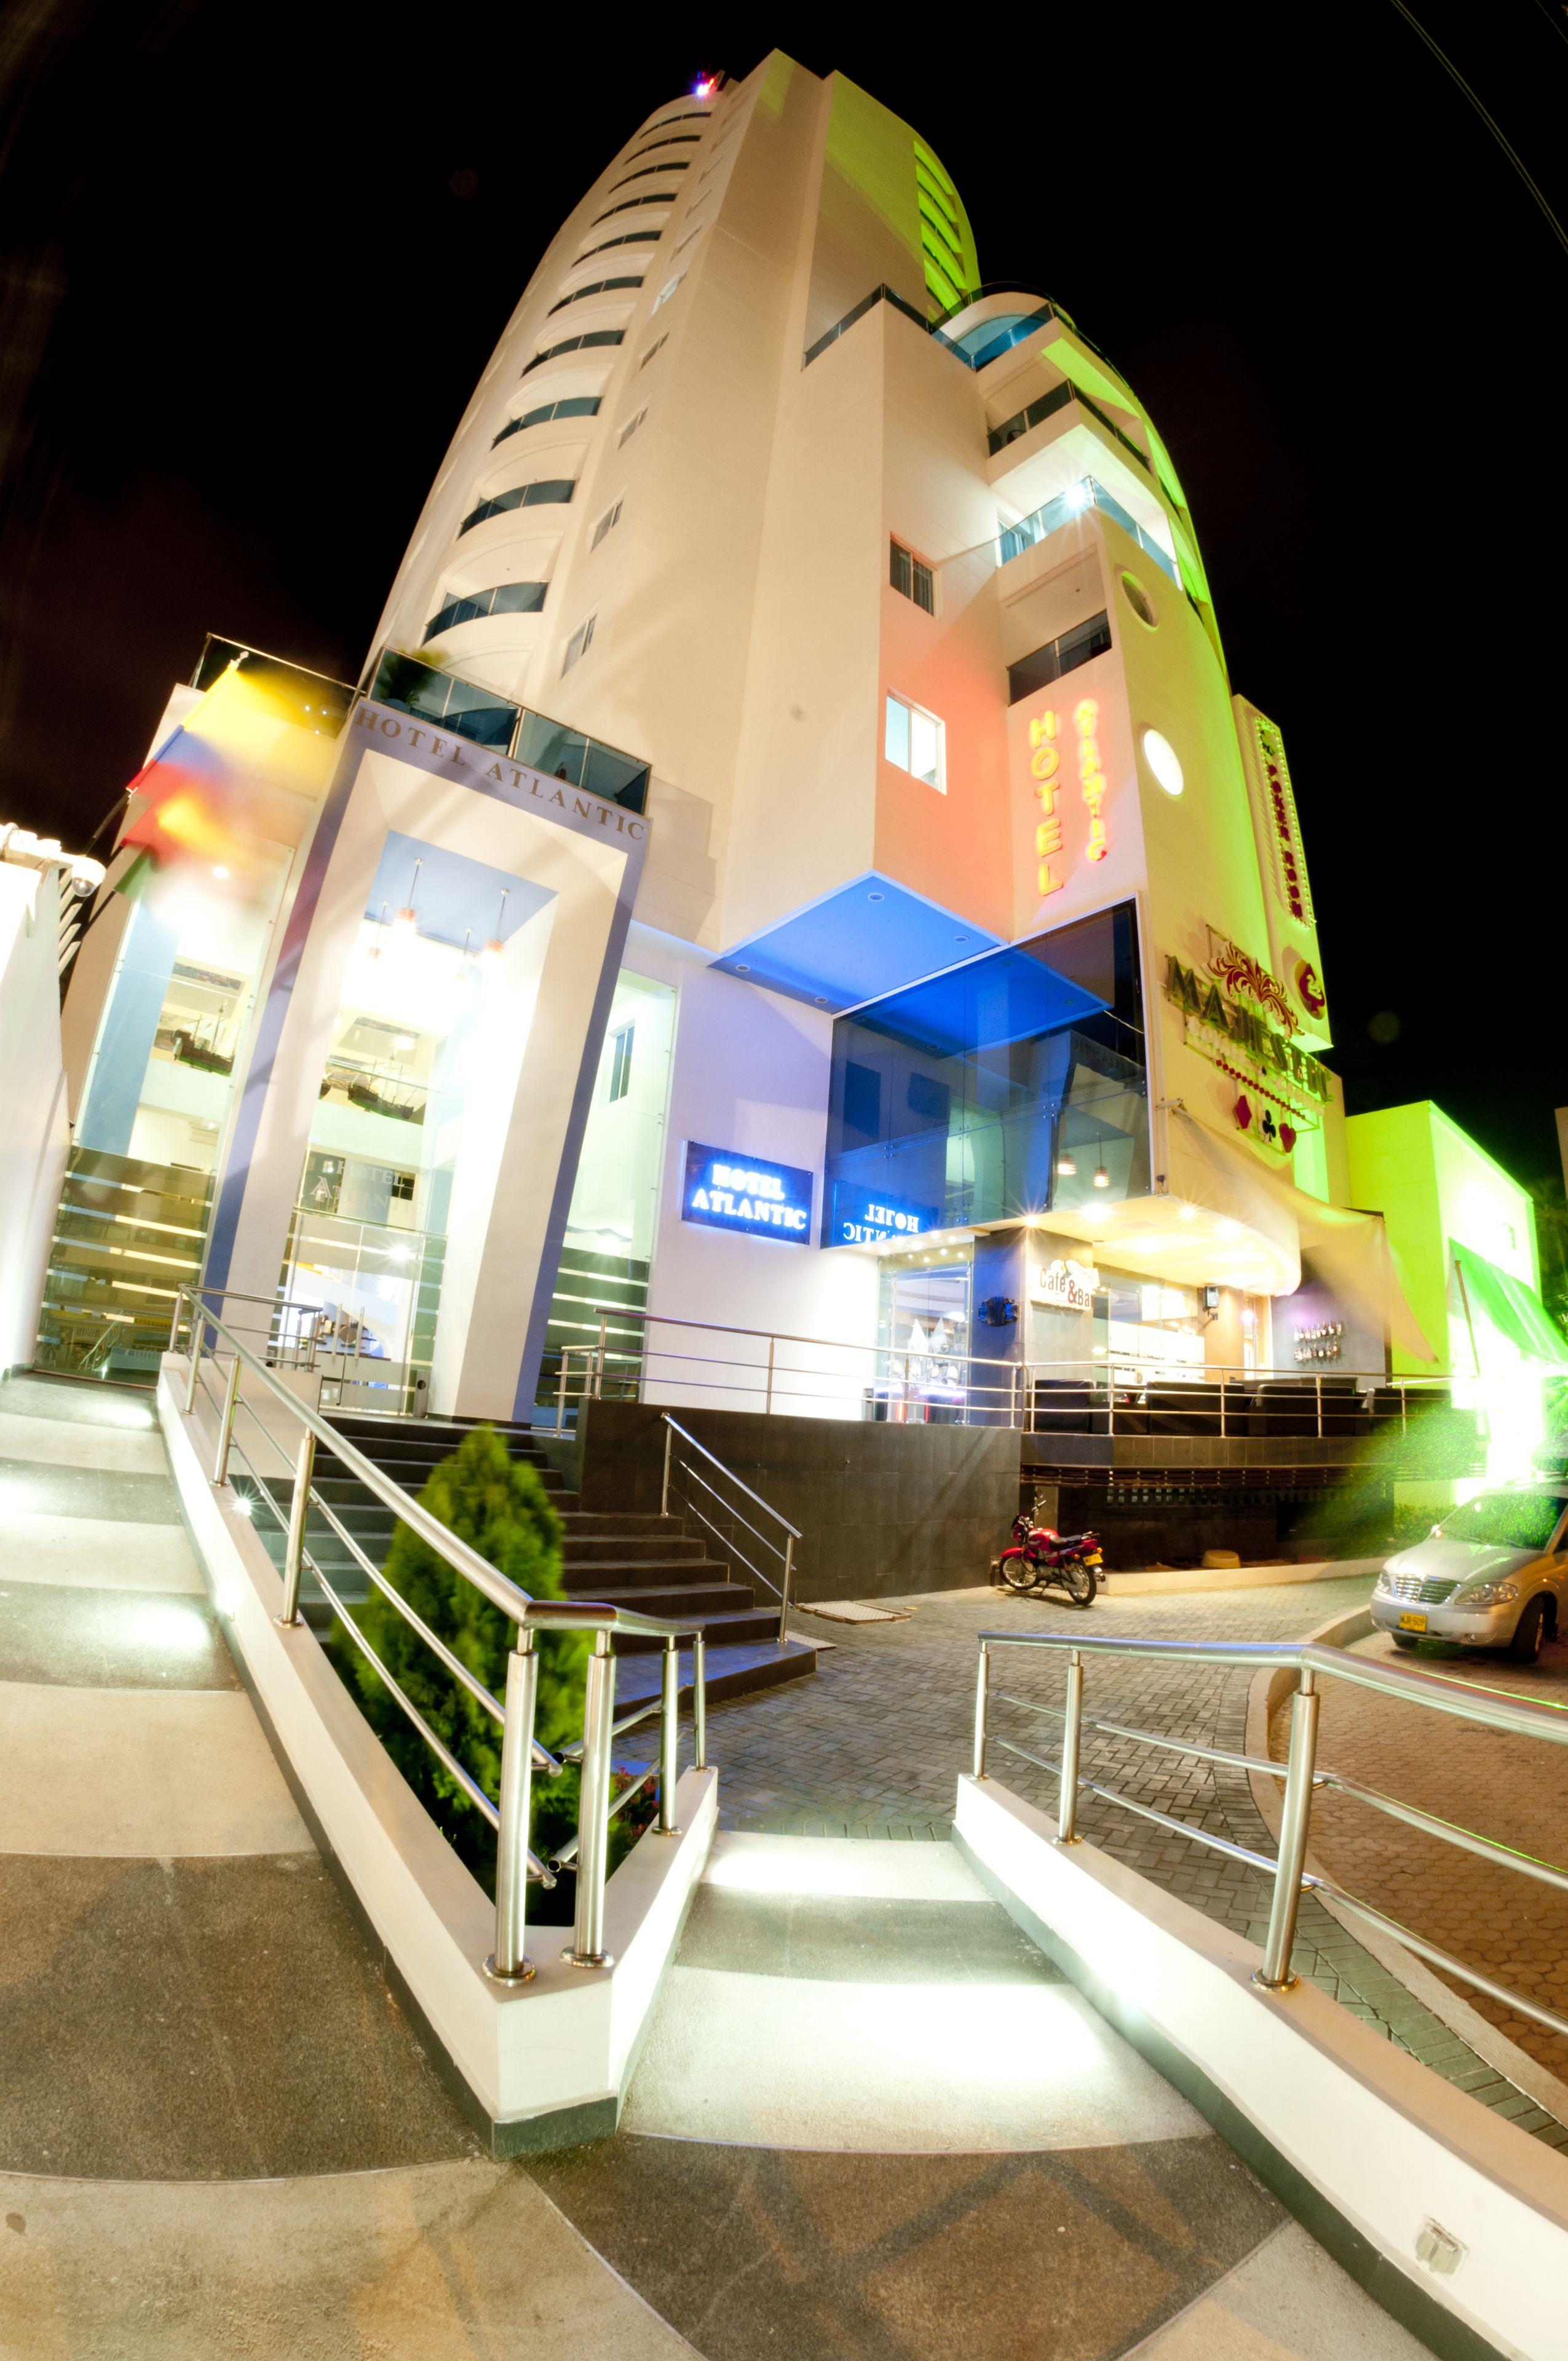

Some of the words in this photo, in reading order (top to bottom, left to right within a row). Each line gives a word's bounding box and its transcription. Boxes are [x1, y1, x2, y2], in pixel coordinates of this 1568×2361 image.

[354, 705, 465, 767] HOTEL
[485, 762, 644, 840] ATLANTIC
[1029, 710, 1063, 896] HOTEL
[692, 1188, 807, 1230] ATLANTIC
[712, 1164, 785, 1200] HOTEL
